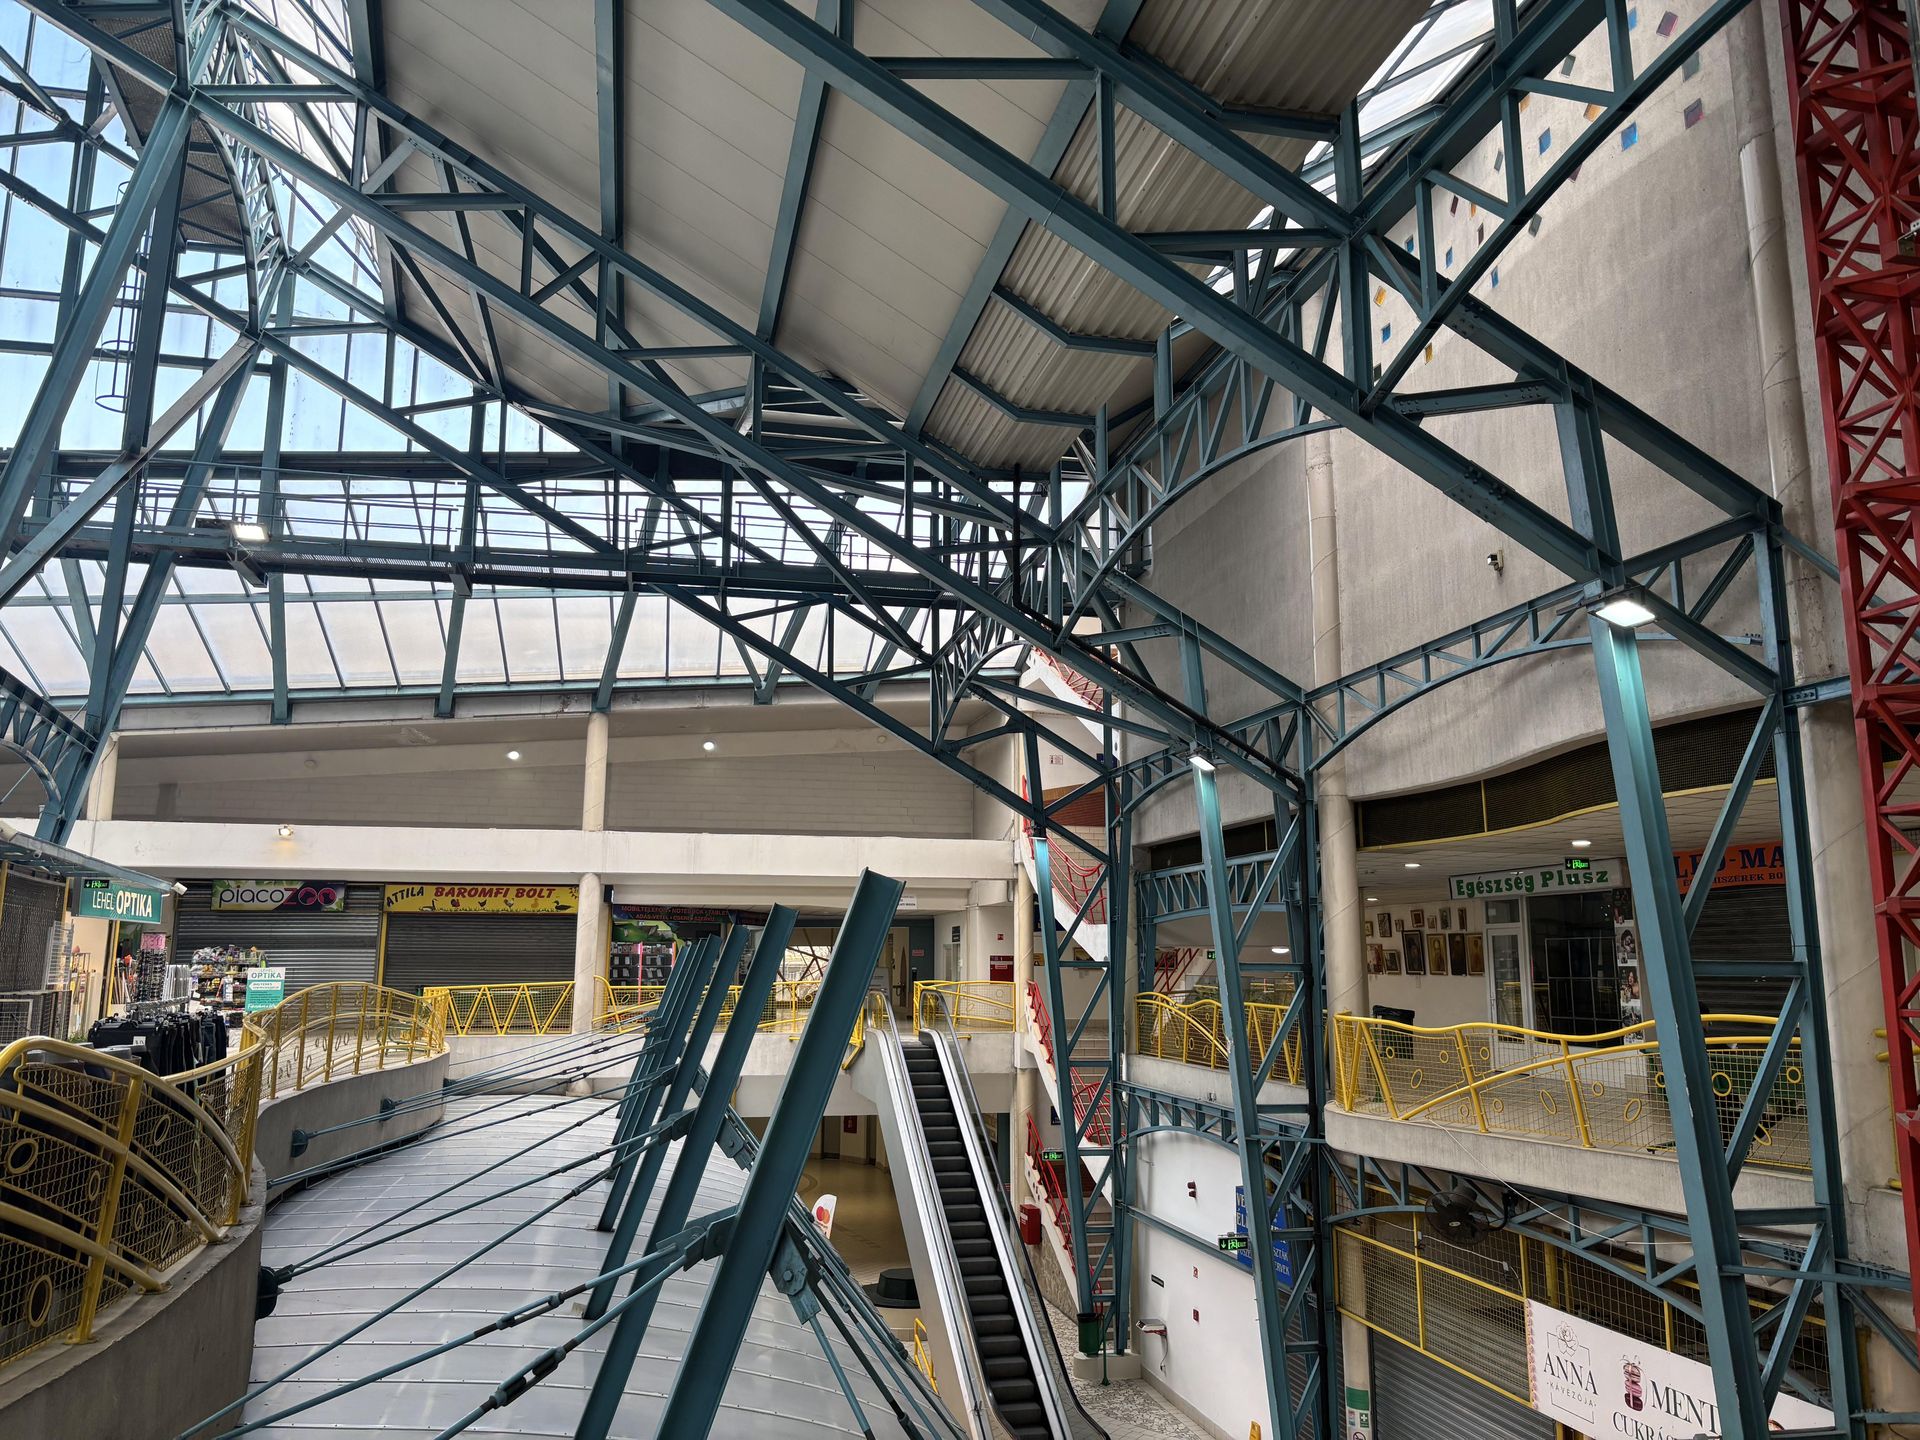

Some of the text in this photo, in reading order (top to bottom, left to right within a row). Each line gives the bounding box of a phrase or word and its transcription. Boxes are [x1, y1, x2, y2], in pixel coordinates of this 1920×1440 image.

[385, 886, 556, 907] ATTILA BAROMFI BOLT
[1456, 870, 1609, 898] Egészség Plusz
[92, 890, 152, 918] LEHEL OPTIKA
[1543, 1352, 1598, 1396] ANNA
